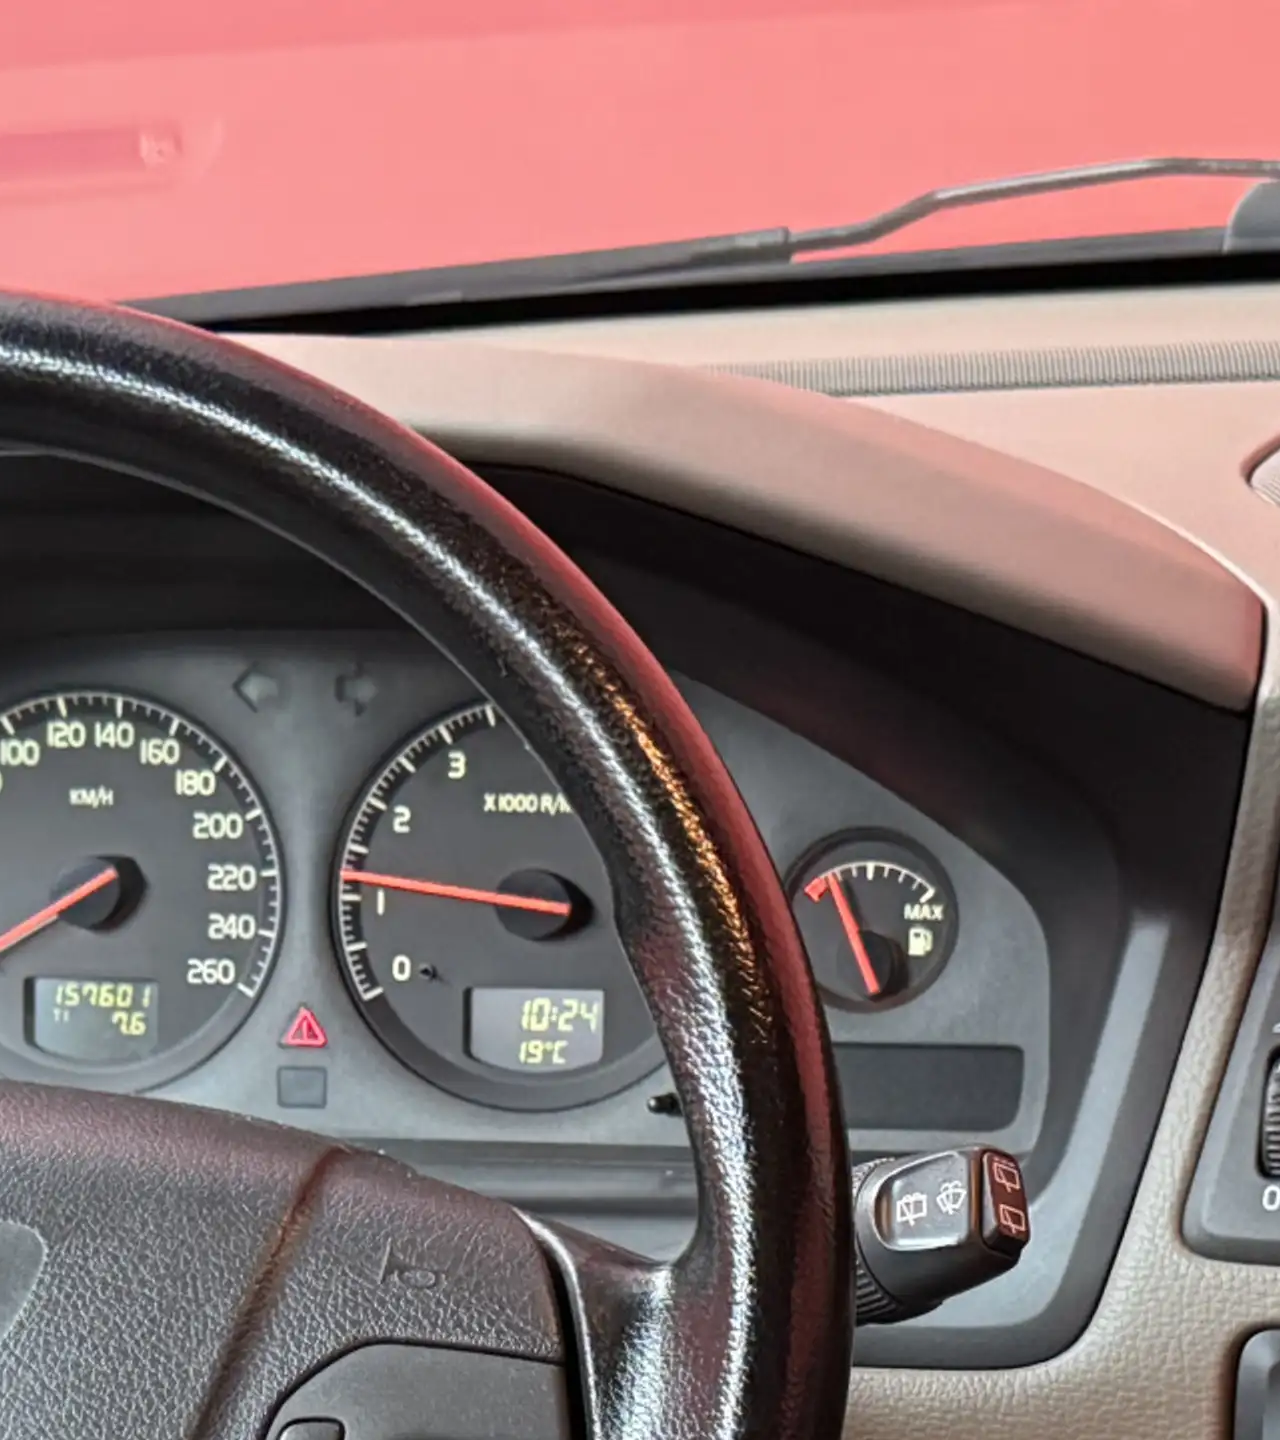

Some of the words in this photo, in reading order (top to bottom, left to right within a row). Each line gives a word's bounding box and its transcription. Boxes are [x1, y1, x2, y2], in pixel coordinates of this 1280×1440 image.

[48, 721, 86, 748] 120
[95, 721, 134, 749] 140
[0, 739, 40, 766] 100
[140, 738, 180, 765] 160
[448, 751, 466, 779] 3
[176, 770, 216, 796] 180
[69, 786, 114, 809] KM/H
[193, 812, 243, 839] 200
[393, 806, 410, 833] 2
[207, 864, 257, 891] 220
[376, 890, 385, 916] 1
[904, 903, 945, 921] MAX
[208, 914, 256, 940] 240
[187, 959, 235, 985] 260
[392, 955, 411, 981] 0
[55, 981, 151, 1008] 157601
[521, 997, 599, 1033] 10:24
[518, 1039, 569, 1064] 19°C
